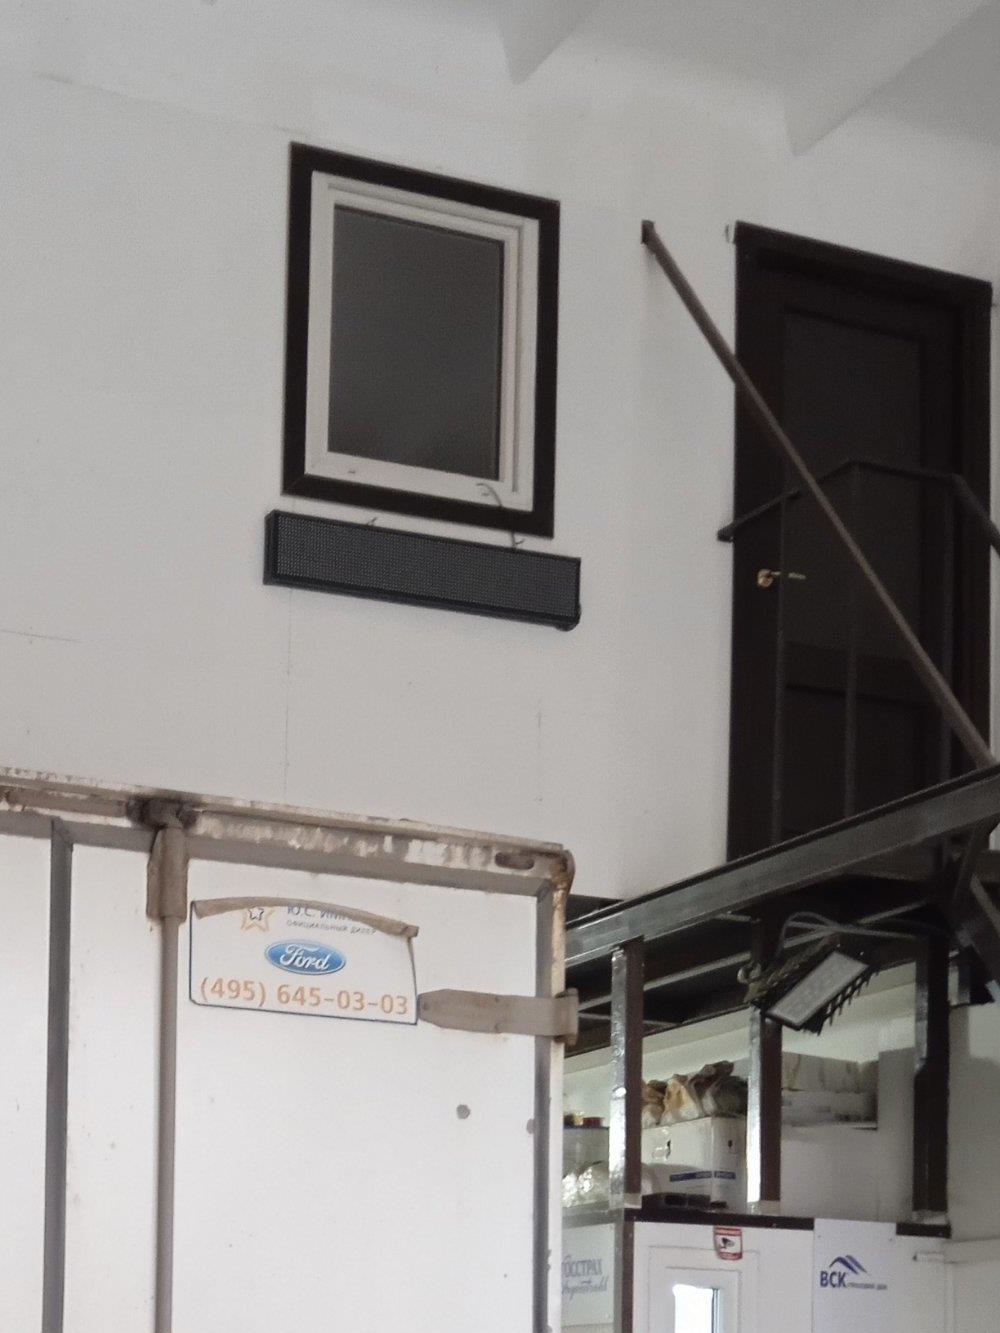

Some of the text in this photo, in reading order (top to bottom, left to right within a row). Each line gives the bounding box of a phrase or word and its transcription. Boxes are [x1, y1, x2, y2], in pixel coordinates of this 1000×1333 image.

[279, 942, 330, 971] Ford
[200, 976, 409, 1016] (495) 645-03-03
[819, 1270, 848, 1288] ВСК
